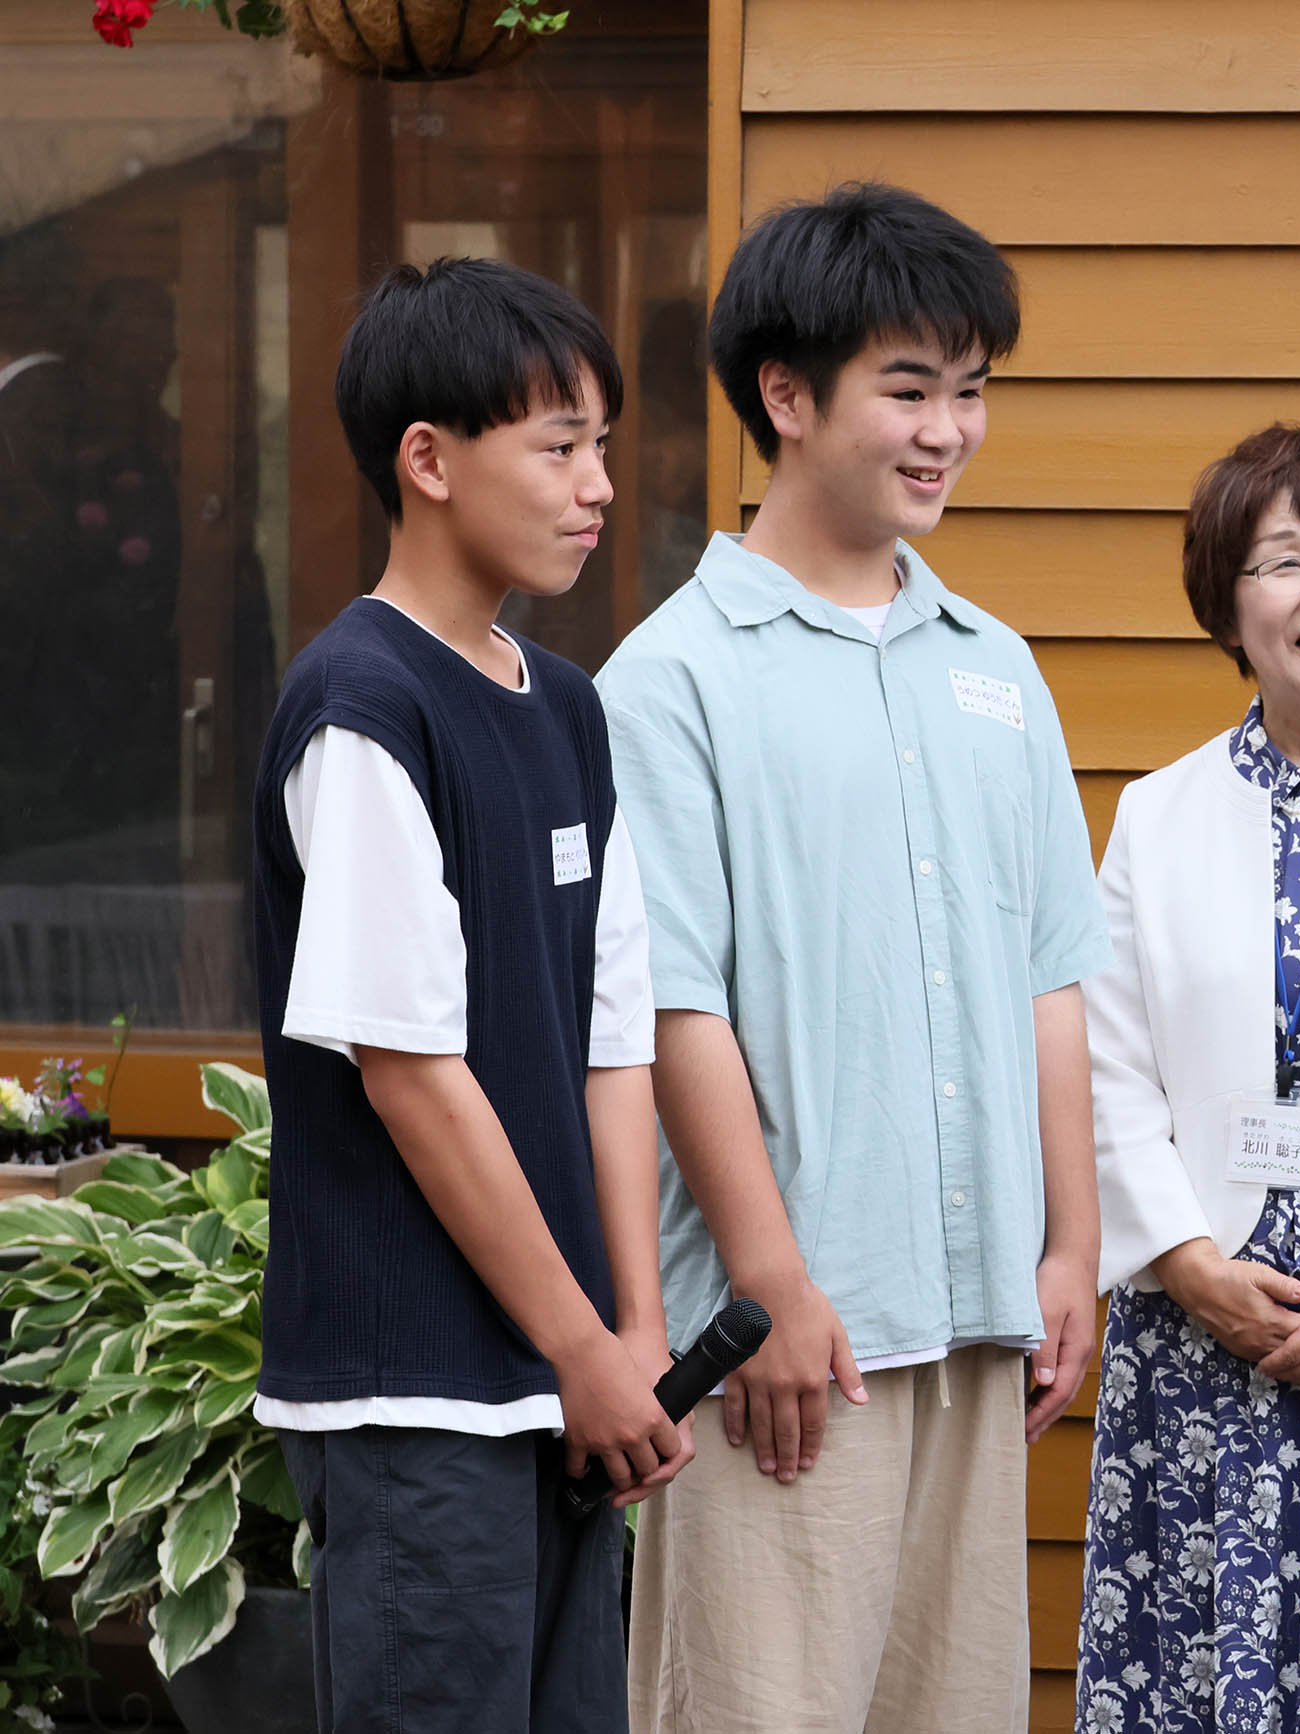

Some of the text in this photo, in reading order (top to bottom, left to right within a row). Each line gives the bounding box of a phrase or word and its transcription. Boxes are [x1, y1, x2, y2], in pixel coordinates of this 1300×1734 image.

[1240, 1117, 1267, 1128] 理事長
[1241, 1139, 1269, 1156] 北川
